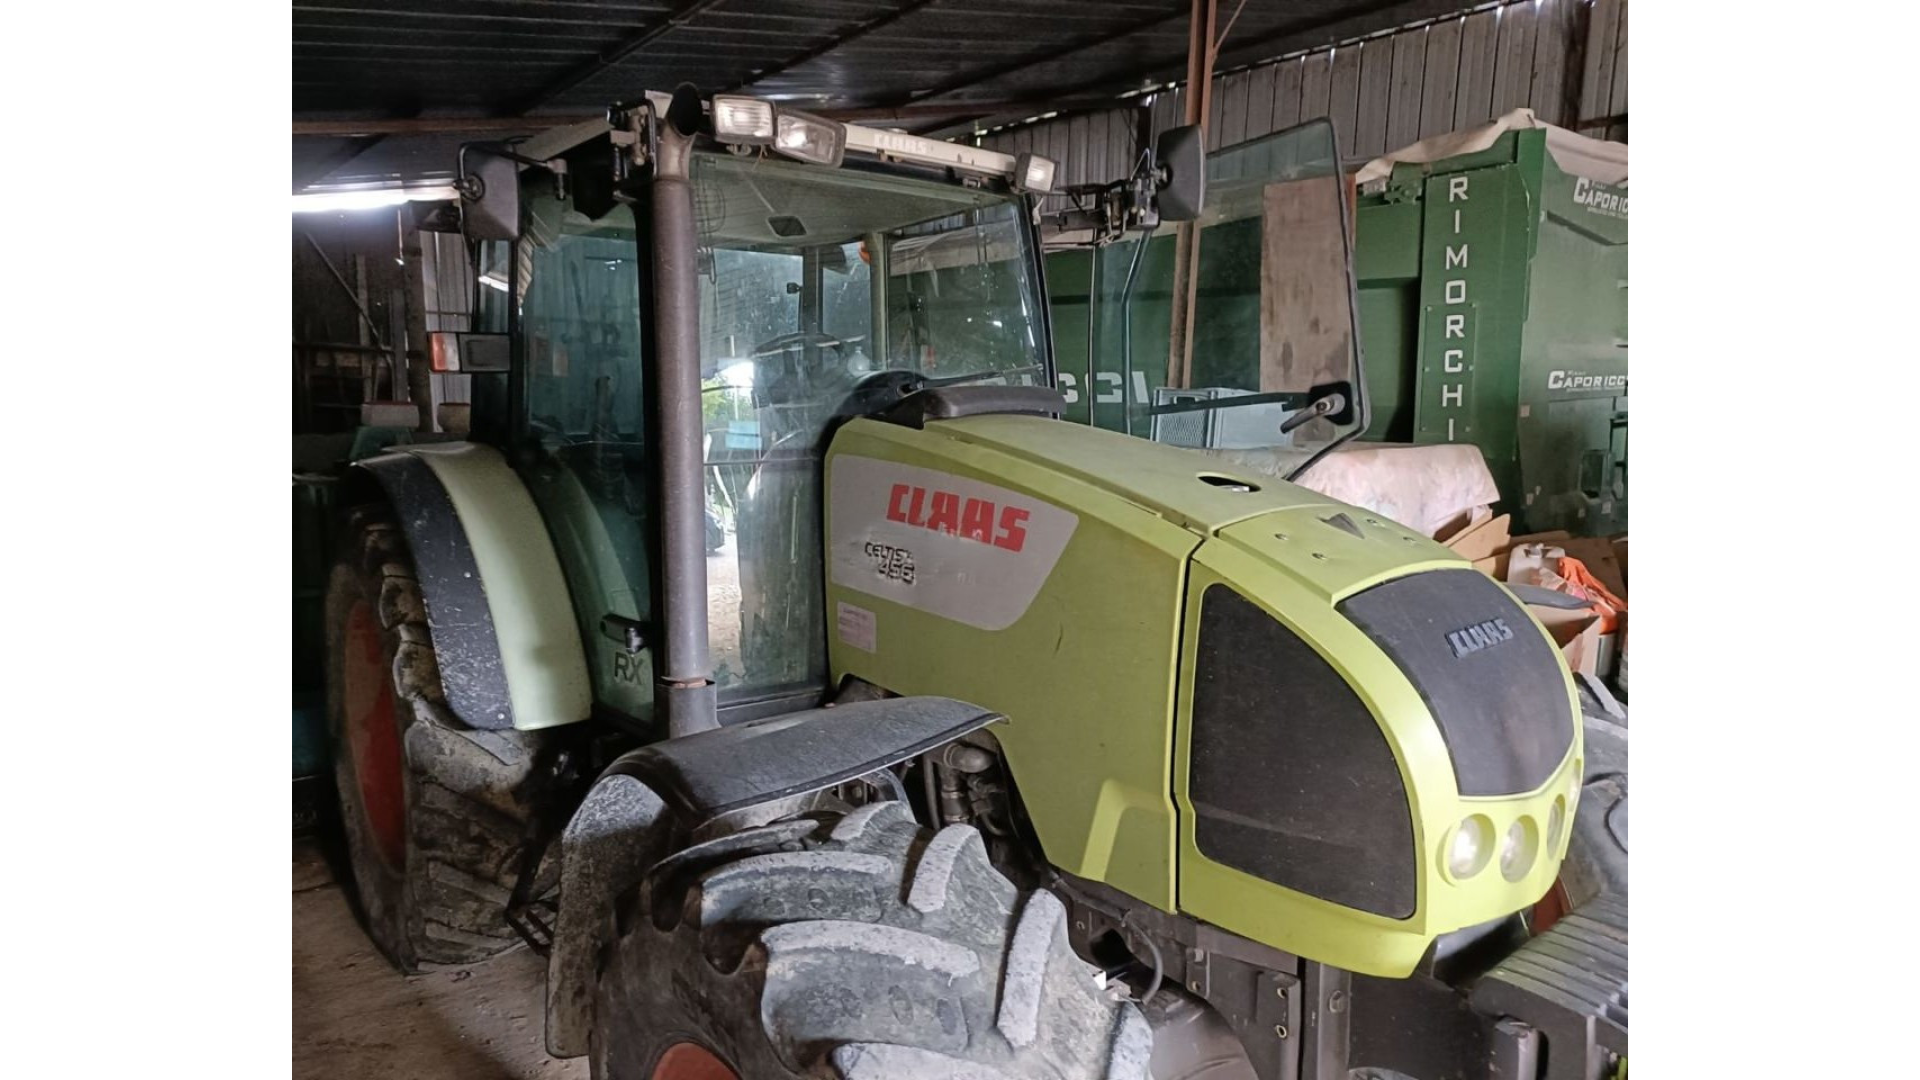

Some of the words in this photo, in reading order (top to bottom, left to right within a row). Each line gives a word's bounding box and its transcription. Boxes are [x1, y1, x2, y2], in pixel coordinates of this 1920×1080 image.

[1441, 176, 1469, 441] RIMORCHI
[1548, 370, 1628, 389] CAPORICC
[886, 484, 1030, 552] CLAAS
[865, 542, 908, 562] CELTIS
[879, 558, 915, 585] 456
[1446, 618, 1513, 658] CLAAS
[615, 652, 644, 685] RX
